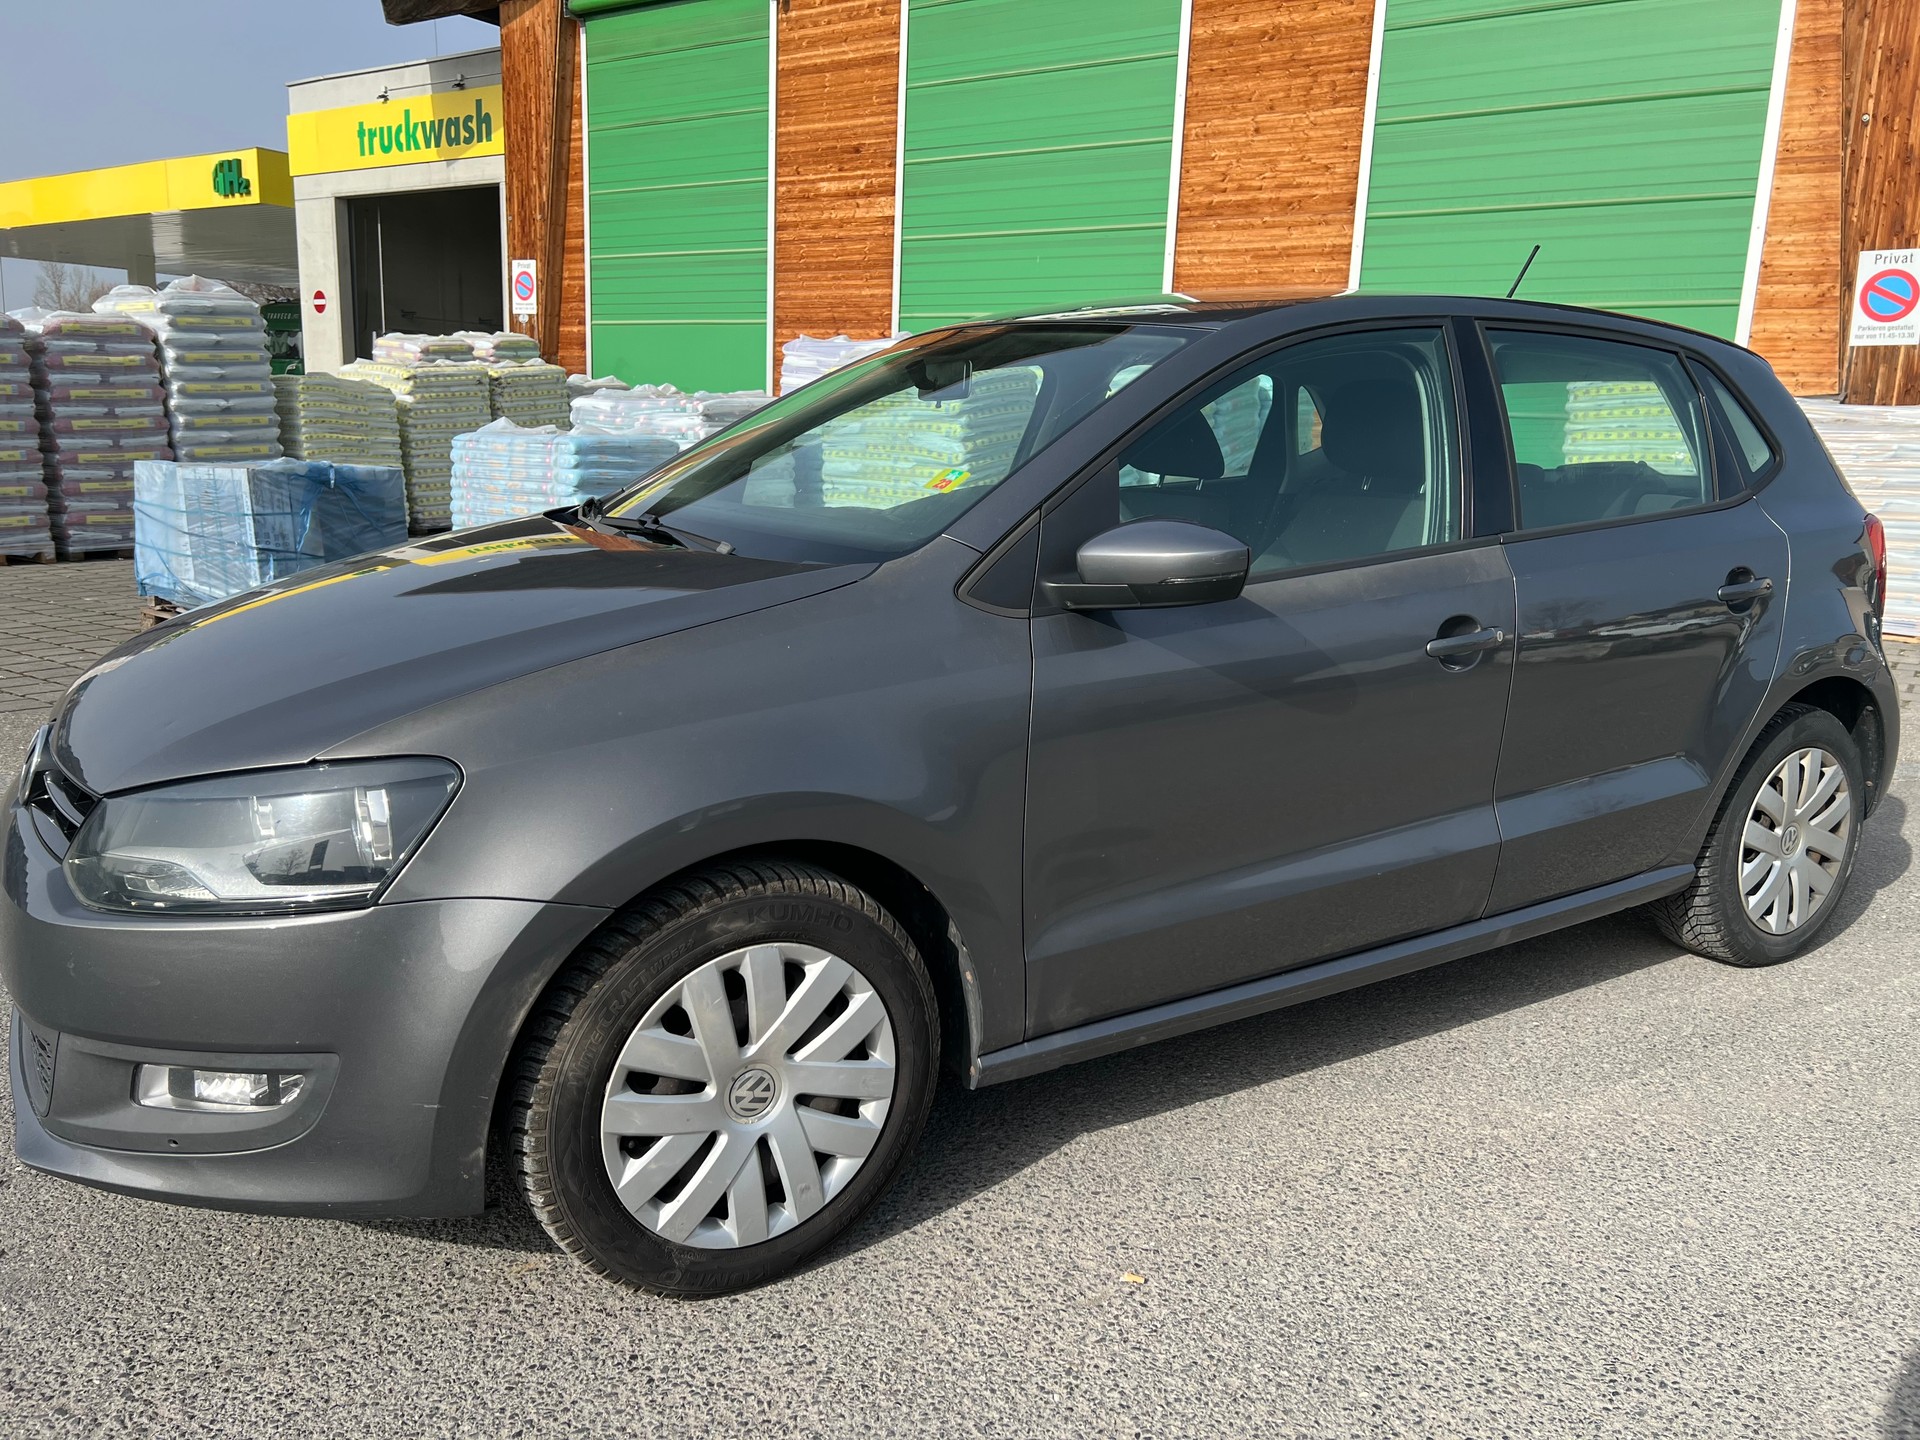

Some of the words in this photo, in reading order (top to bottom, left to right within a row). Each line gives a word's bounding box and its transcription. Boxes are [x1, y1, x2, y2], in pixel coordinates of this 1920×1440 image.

[357, 98, 493, 157] truckwash
[1874, 252, 1914, 265] Privat
[267, 312, 292, 320] TRAVECO
[1857, 324, 1886, 332] Parkieren
[1887, 324, 1914, 332] gestattet
[746, 903, 855, 935] KUMHO
